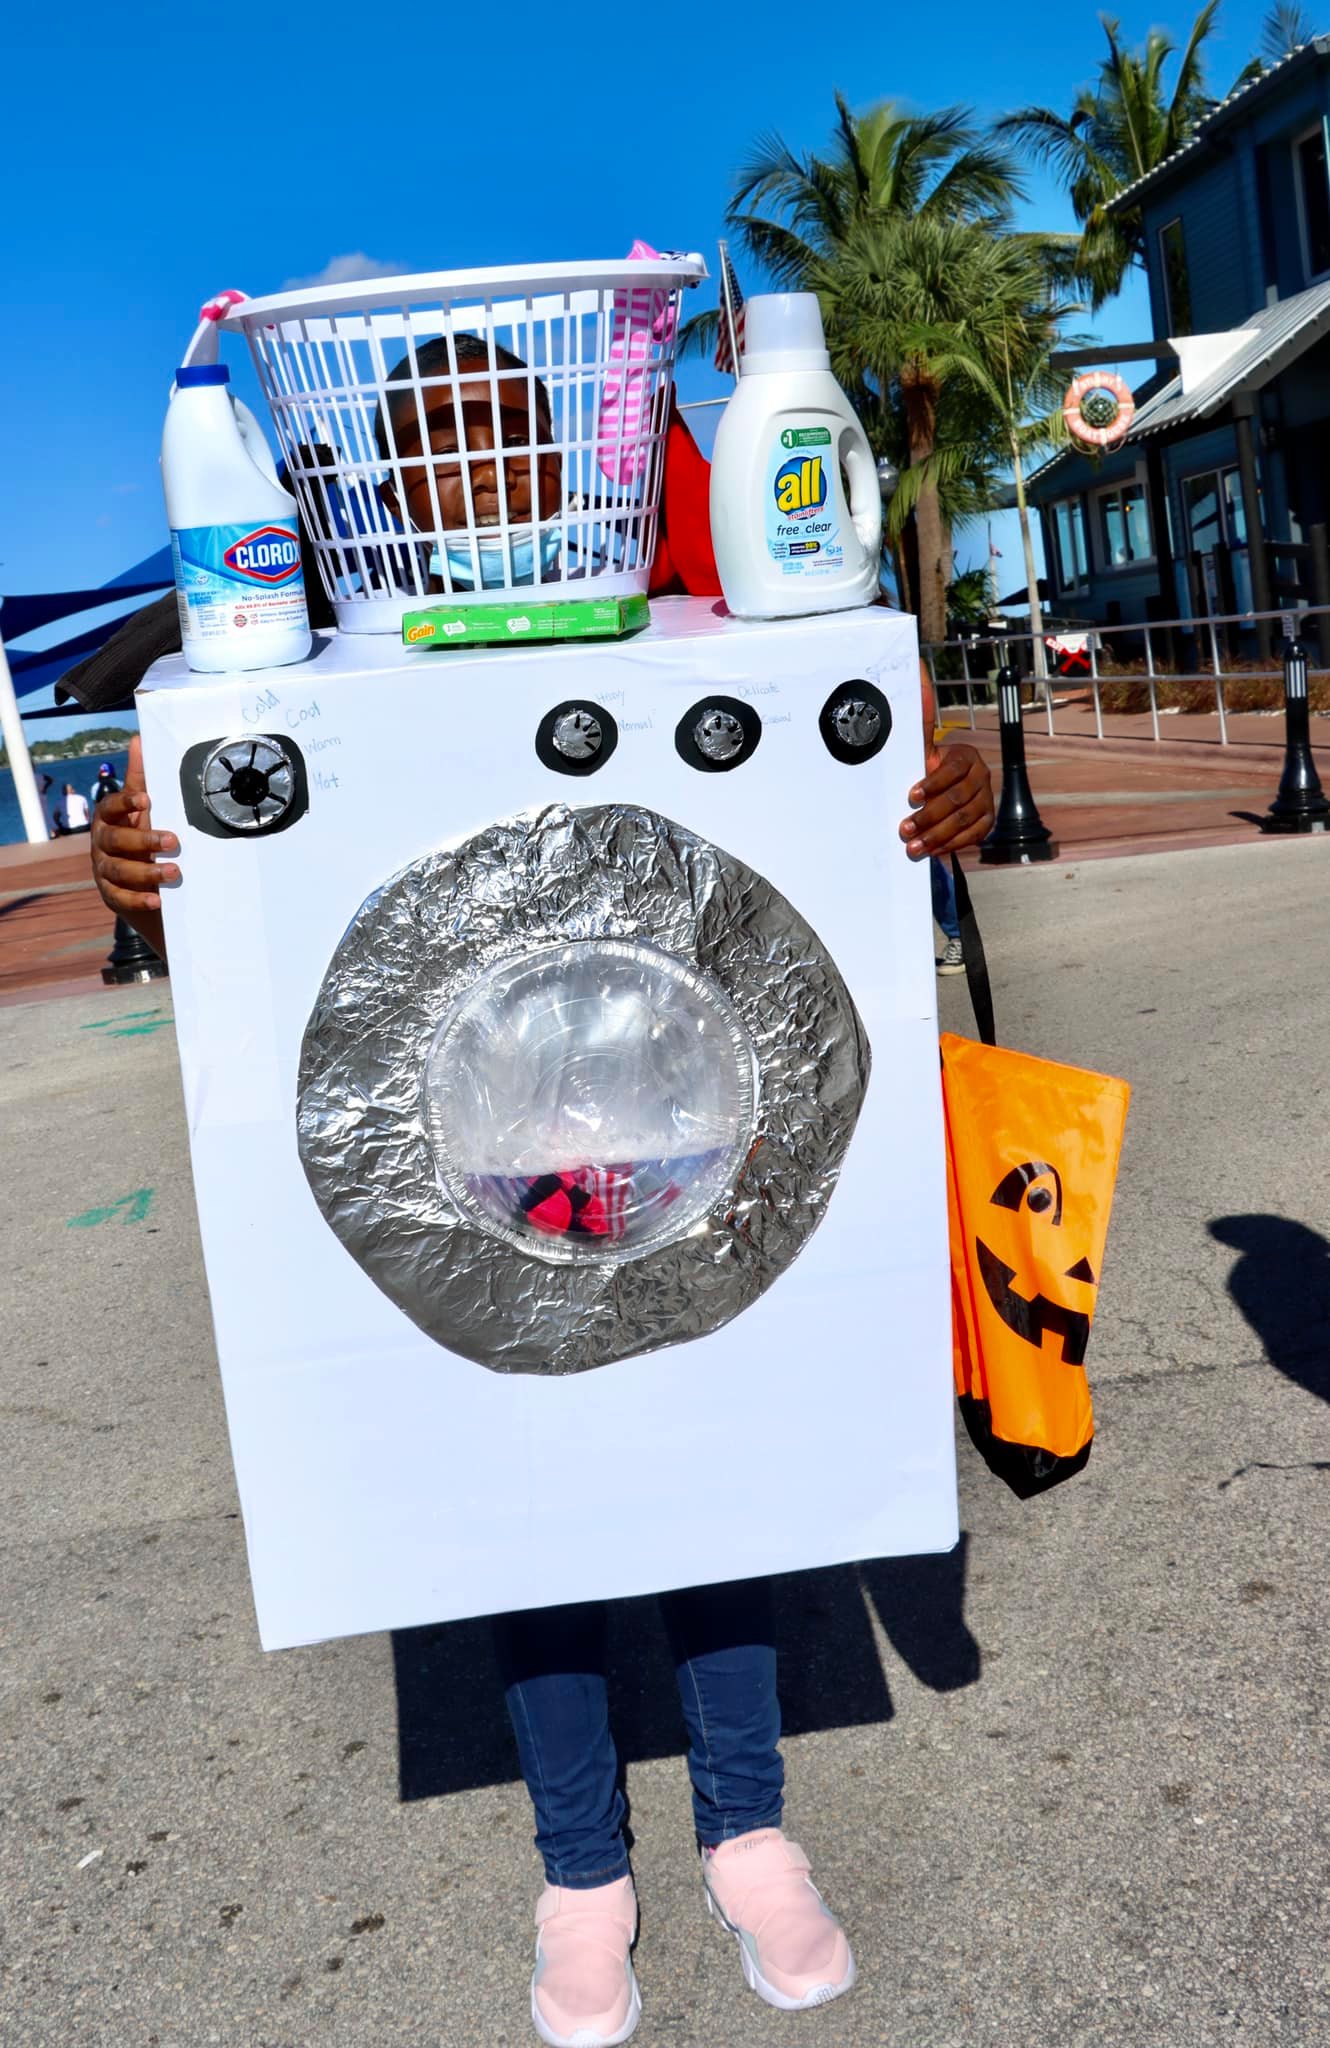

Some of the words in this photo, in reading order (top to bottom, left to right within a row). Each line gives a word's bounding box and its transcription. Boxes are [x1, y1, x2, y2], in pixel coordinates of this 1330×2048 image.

[777, 455, 822, 512] all
[776, 524, 800, 538] free
[805, 521, 832, 535] clear
[241, 591, 280, 603] No-Splash
[407, 623, 436, 643] Gain
[242, 689, 280, 724] Cold
[286, 700, 321, 728] Cool
[312, 772, 340, 791] Hot
